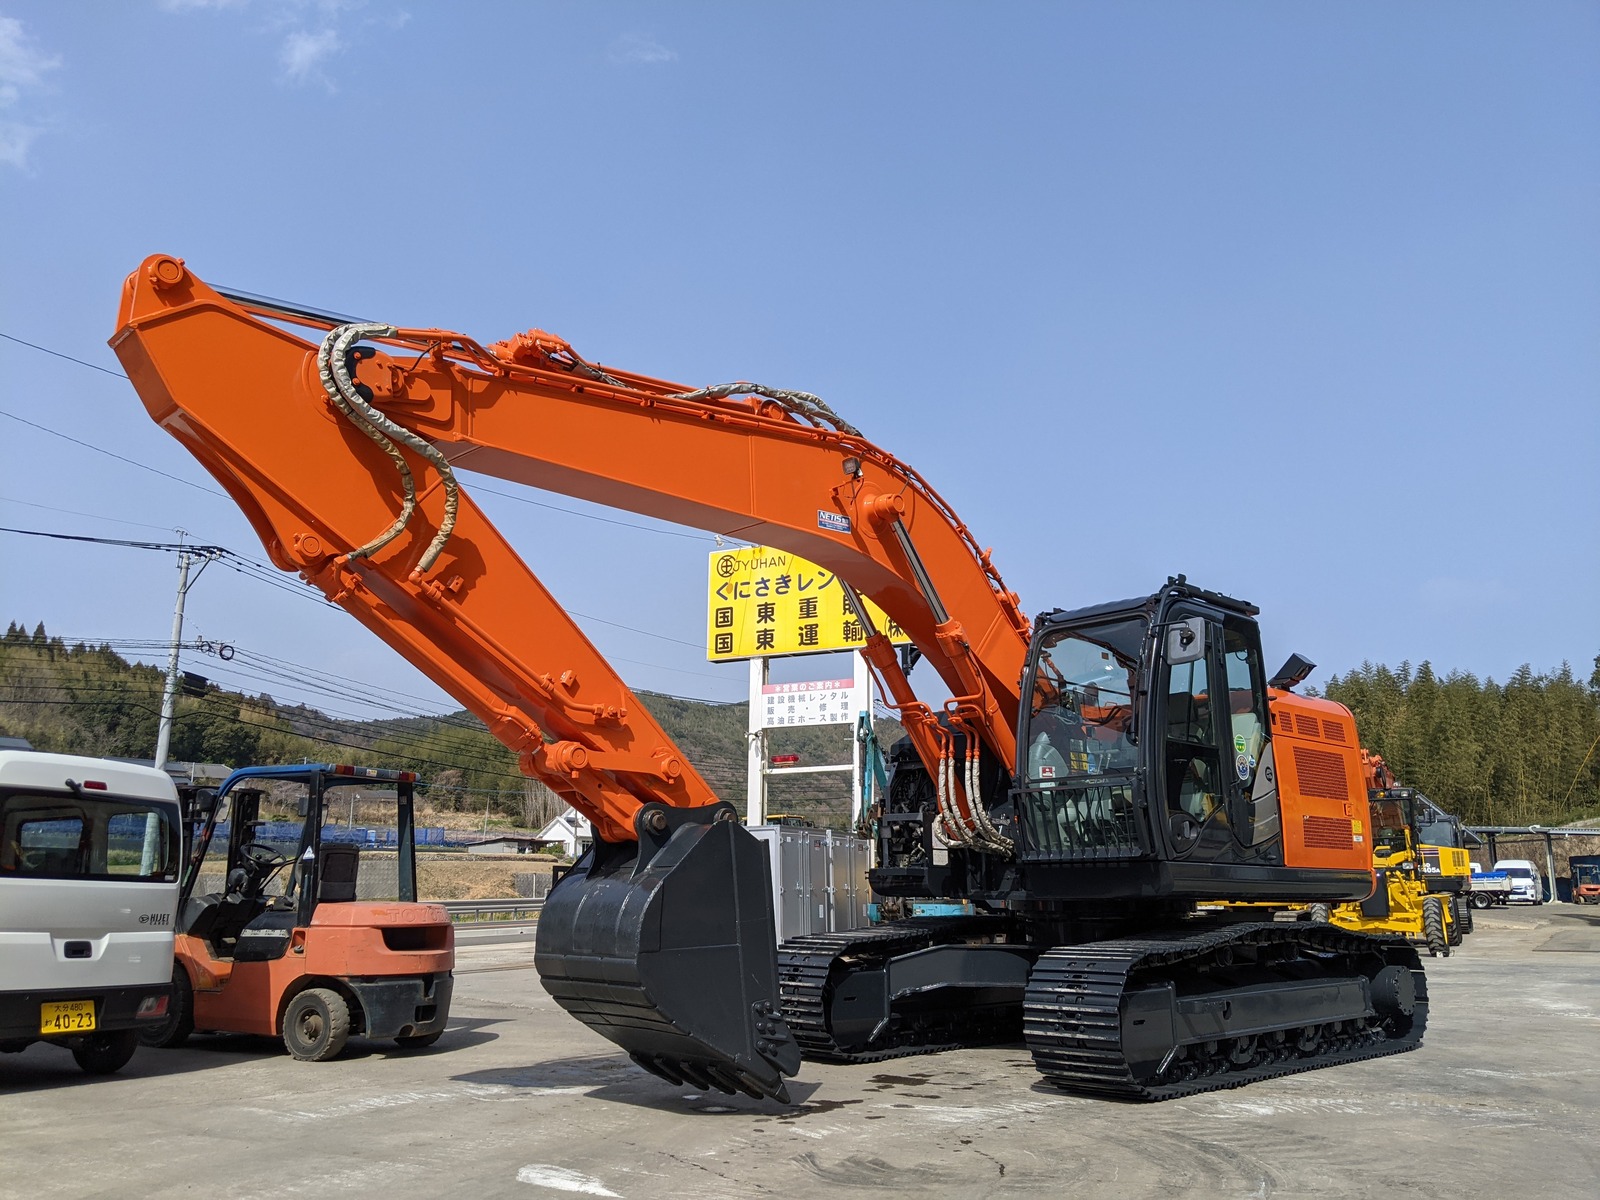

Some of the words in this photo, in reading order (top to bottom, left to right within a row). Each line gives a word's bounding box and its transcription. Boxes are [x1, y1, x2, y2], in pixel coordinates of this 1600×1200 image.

[819, 511, 842, 523] NETIS
[733, 555, 786, 572] JYUHAN
[767, 691, 849, 705] 建設機械レンタル
[150, 913, 171, 922] HIJET
[54, 1004, 69, 1012] 大分
[70, 1003, 84, 1011] 480
[44, 1018, 53, 1026] わ
[54, 1012, 93, 1030] 40-23
